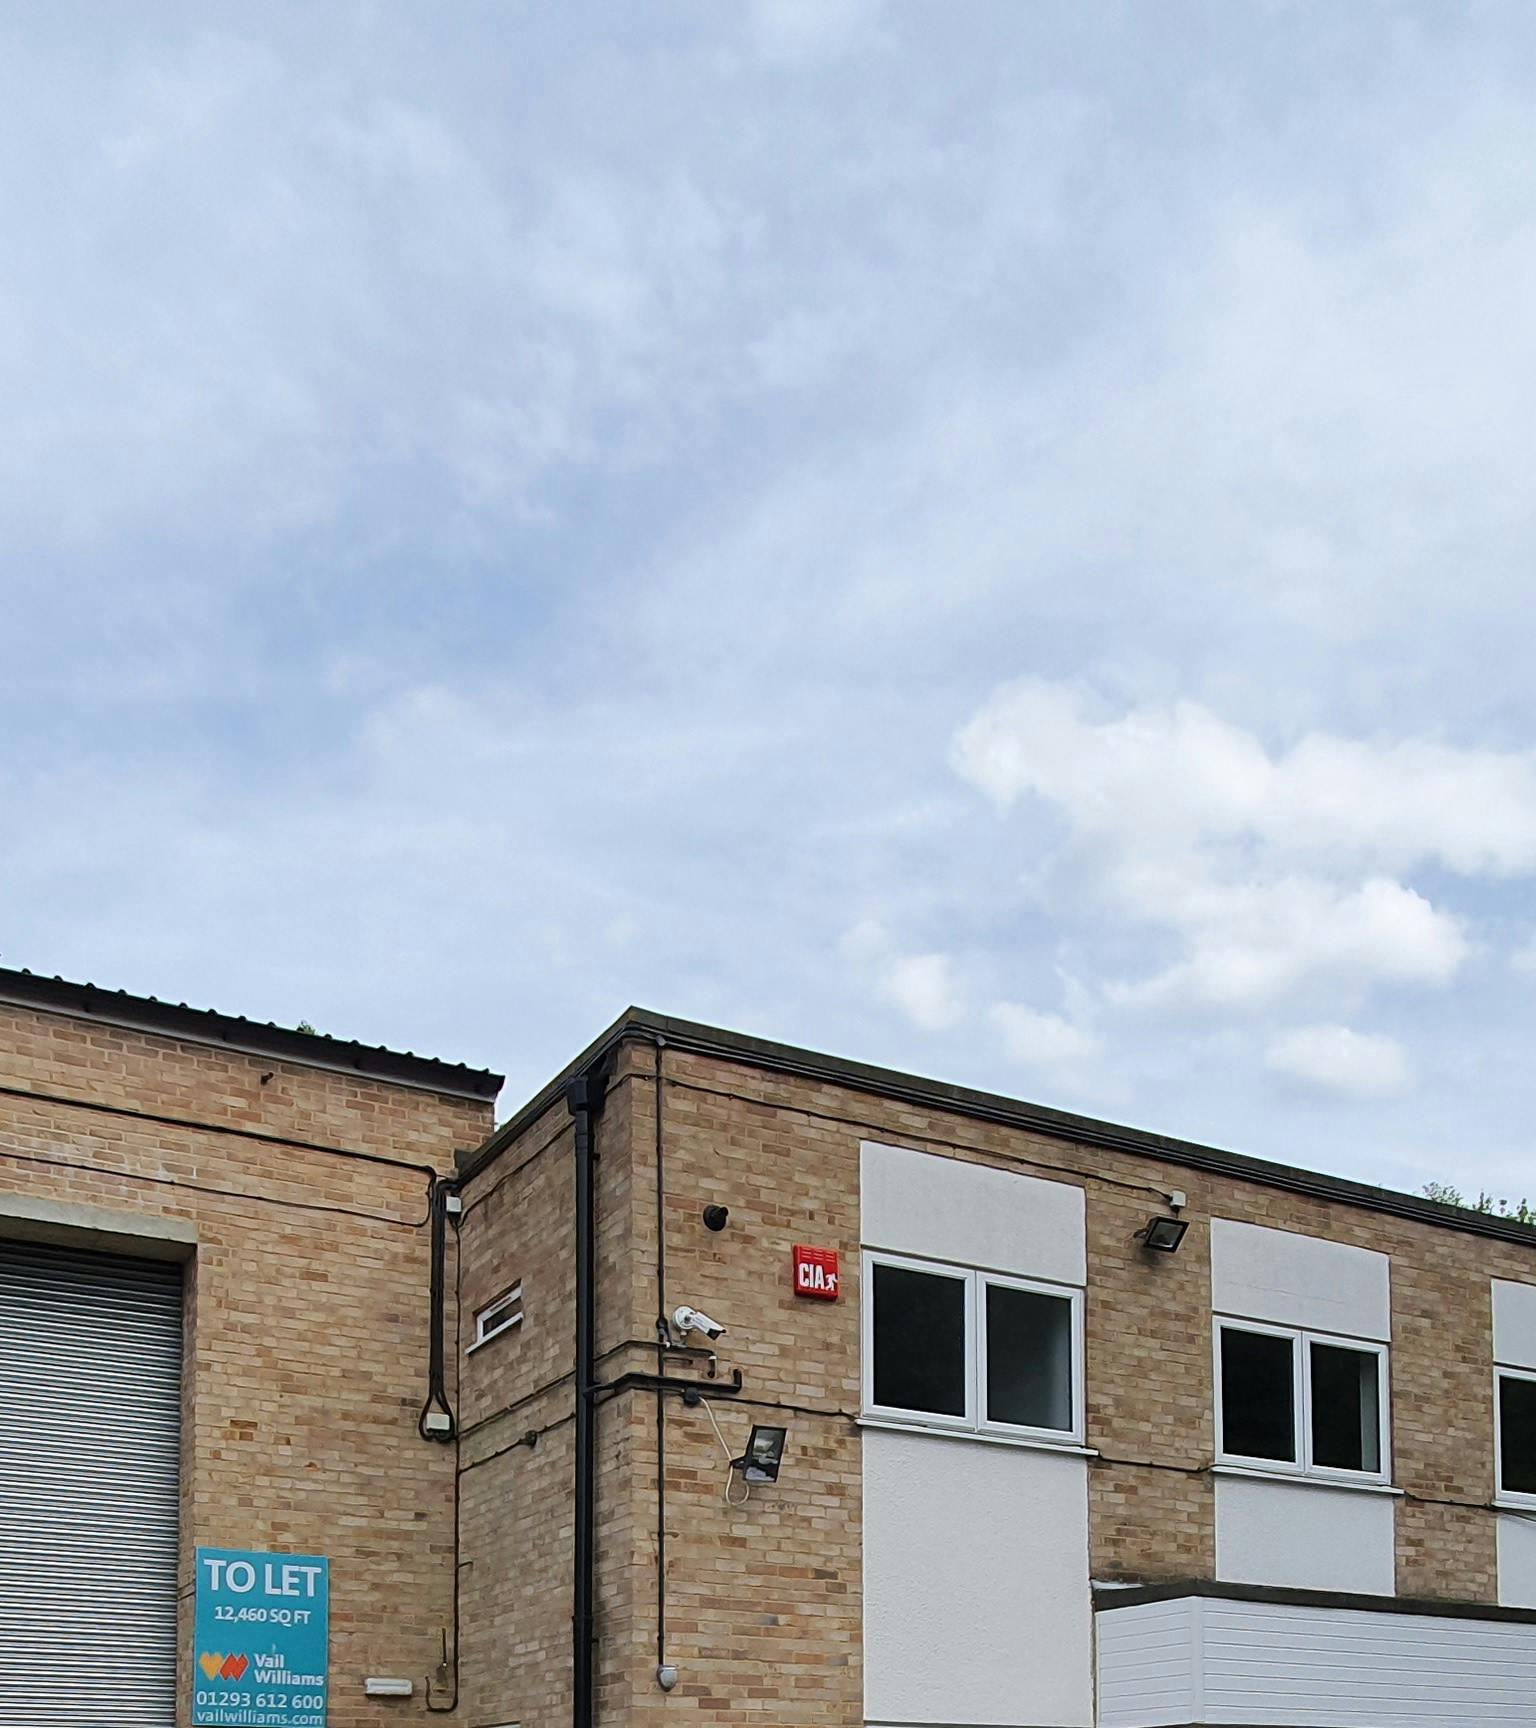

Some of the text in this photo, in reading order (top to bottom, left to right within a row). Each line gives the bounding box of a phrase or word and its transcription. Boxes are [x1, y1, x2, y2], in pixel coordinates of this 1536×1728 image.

[799, 1262, 825, 1290] CIA
[203, 1559, 322, 1598] TO LET
[214, 1606, 311, 1627] 12,460 SQ FT
[253, 1653, 285, 1668] Vail
[253, 1668, 325, 1687] Williams
[196, 1690, 324, 1710] 01293 612 600
[196, 1709, 323, 1726] vailwilliams.com
